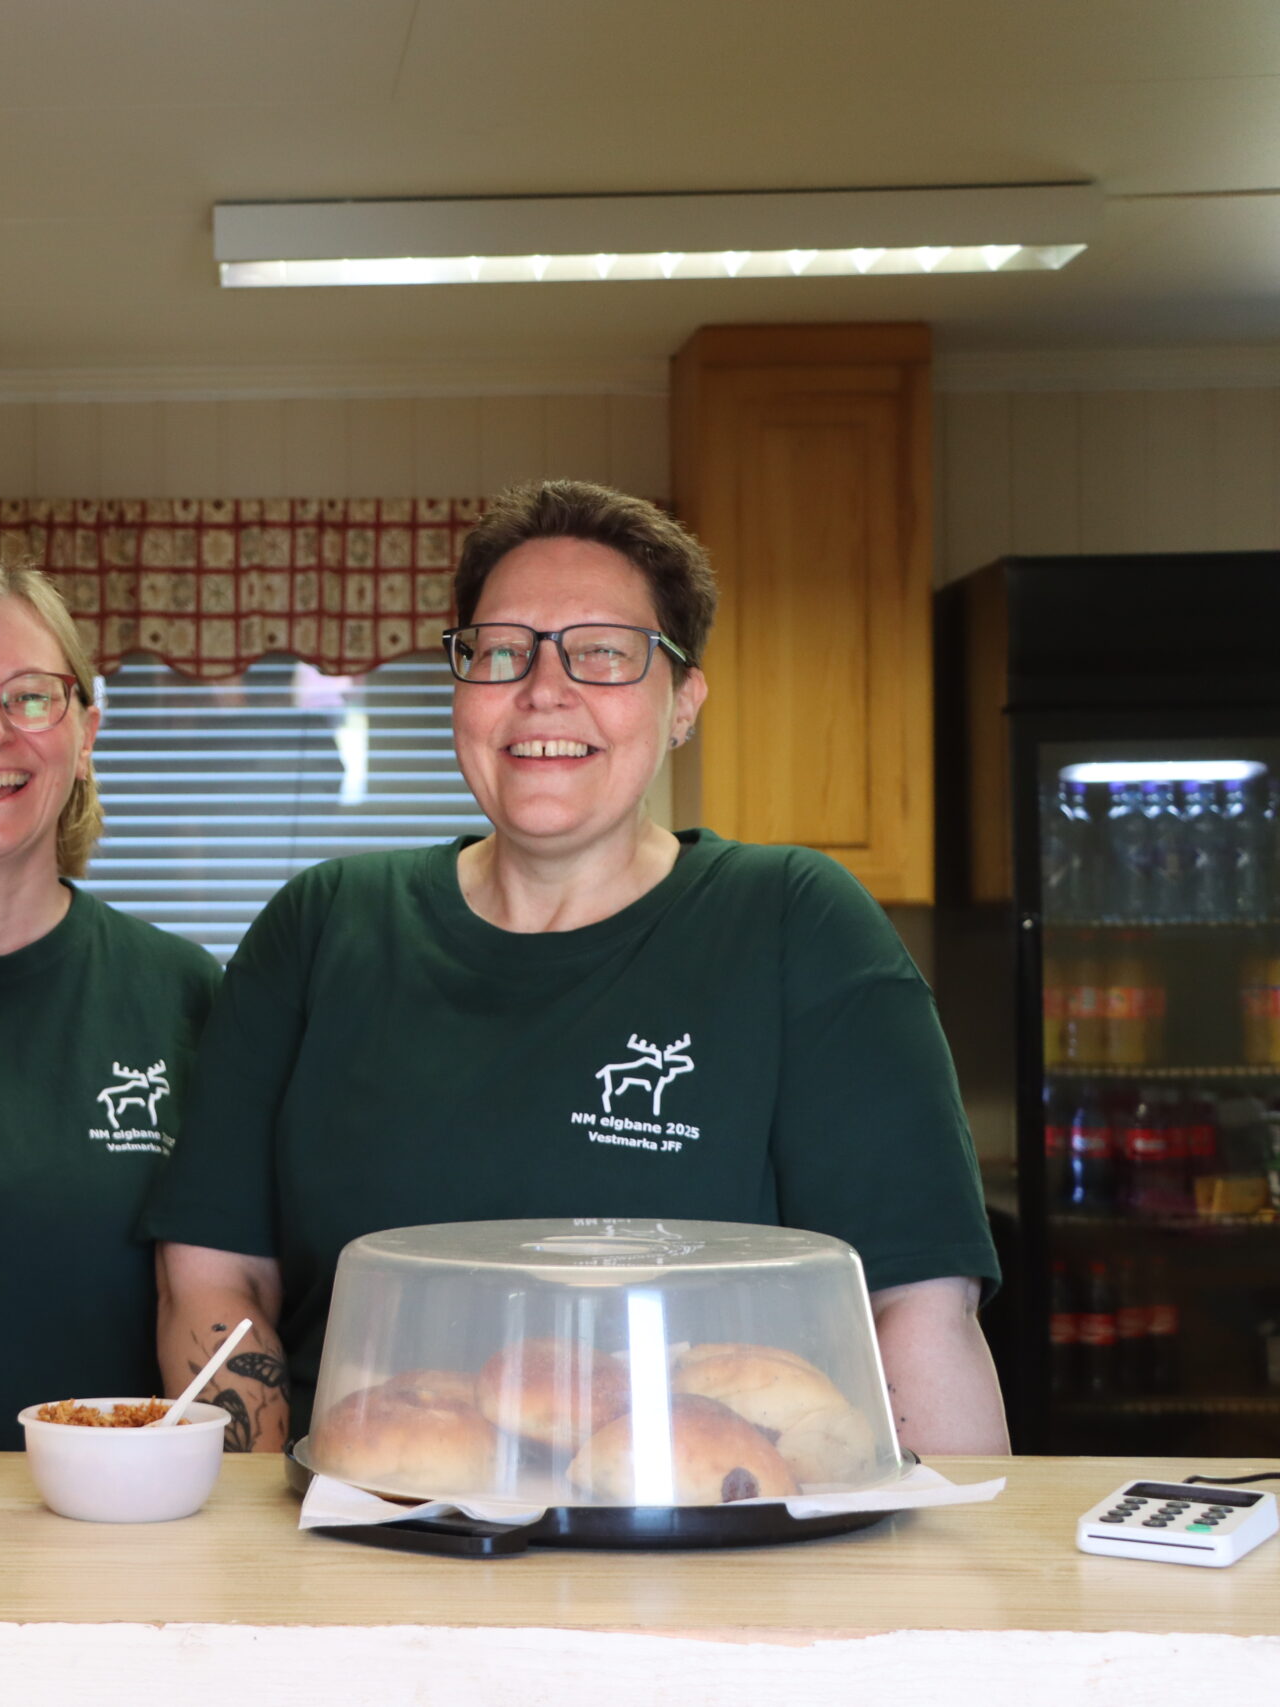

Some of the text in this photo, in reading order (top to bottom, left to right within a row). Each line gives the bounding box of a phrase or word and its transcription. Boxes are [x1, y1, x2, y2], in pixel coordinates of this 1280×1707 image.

[571, 1112, 700, 1139] NM elgbane 2025
[89, 1128, 110, 1140] NM
[112, 1128, 161, 1141] elgbane
[588, 1131, 682, 1152] Vestmarka JFF
[106, 1142, 162, 1153] Vestmarka
